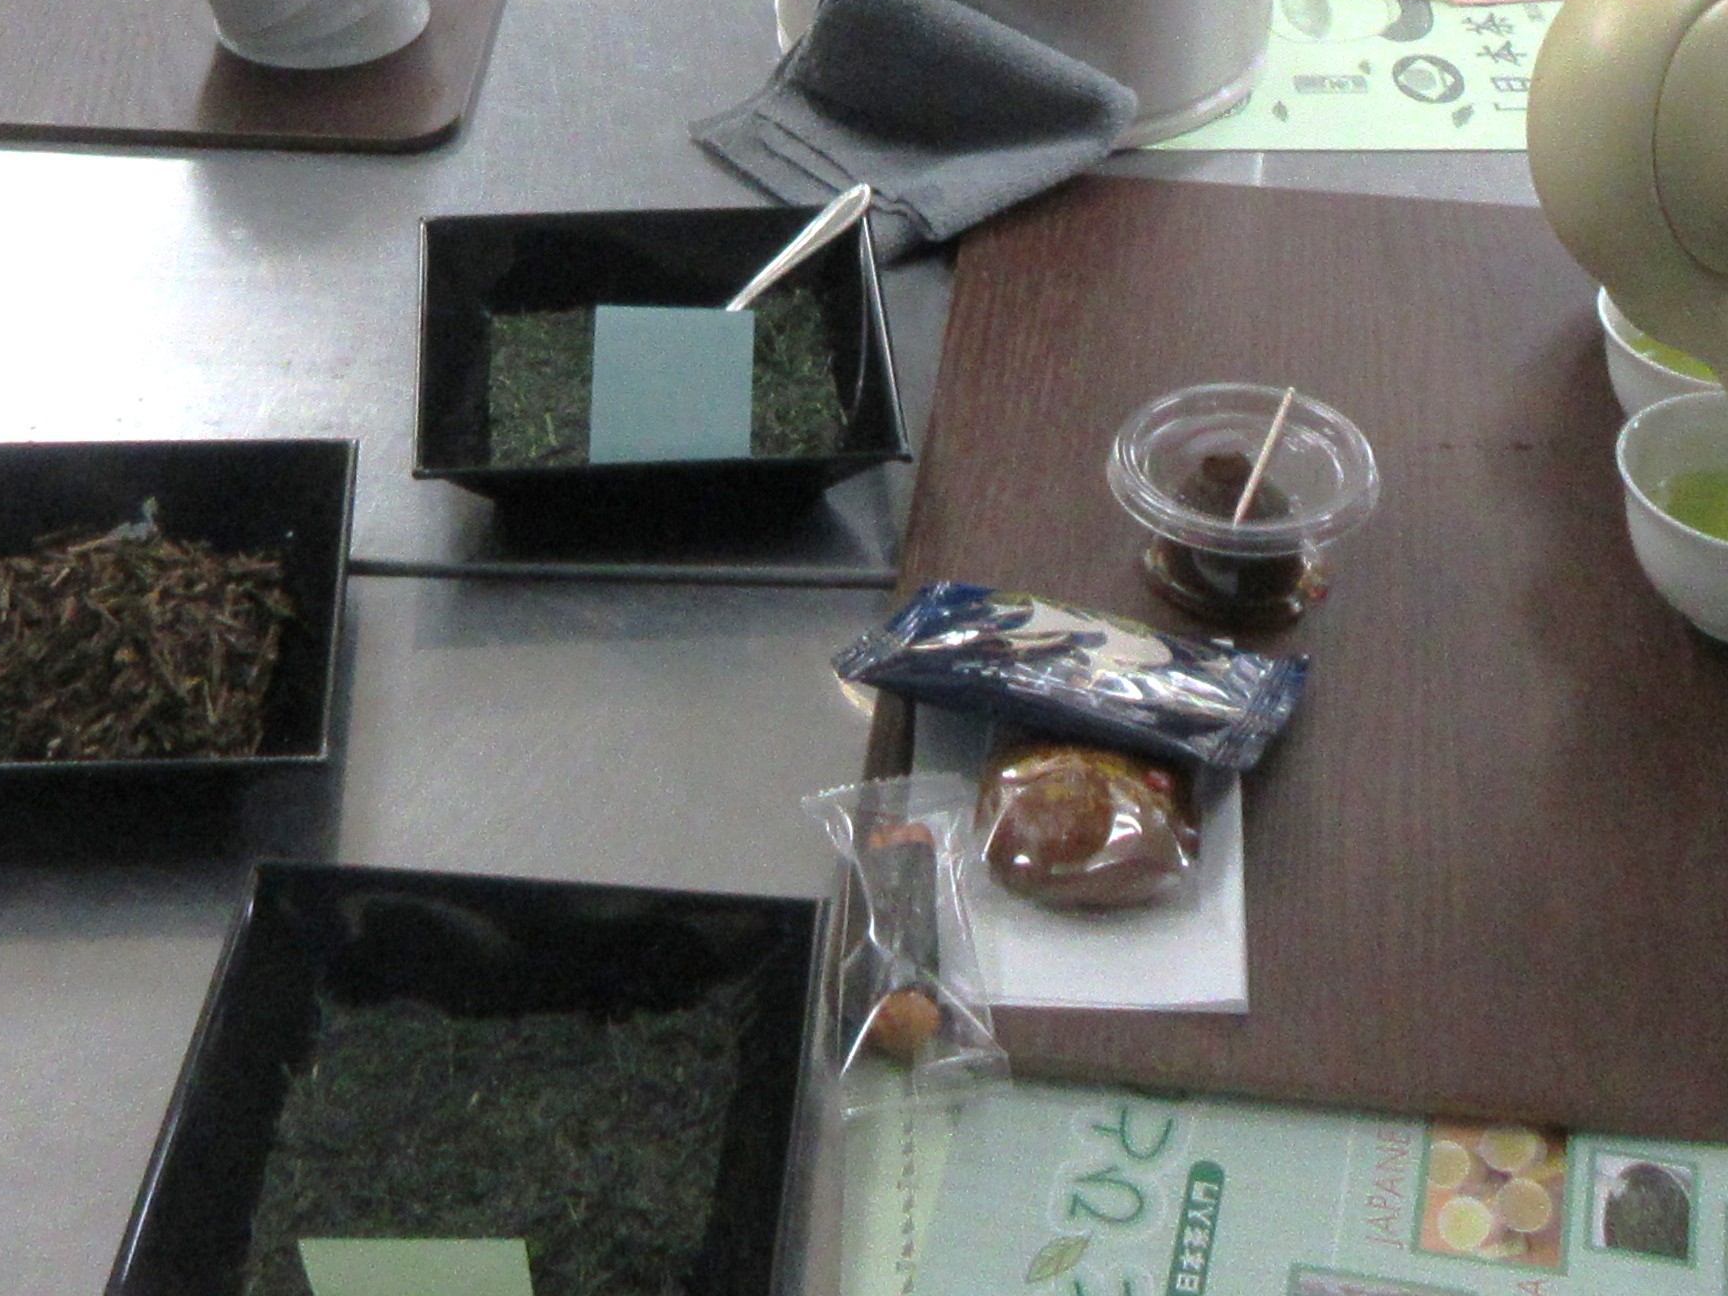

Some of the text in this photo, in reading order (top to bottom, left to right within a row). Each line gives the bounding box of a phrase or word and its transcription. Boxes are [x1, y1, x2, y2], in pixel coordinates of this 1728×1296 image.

[1175, 1179, 1219, 1295] 日本茶入門
